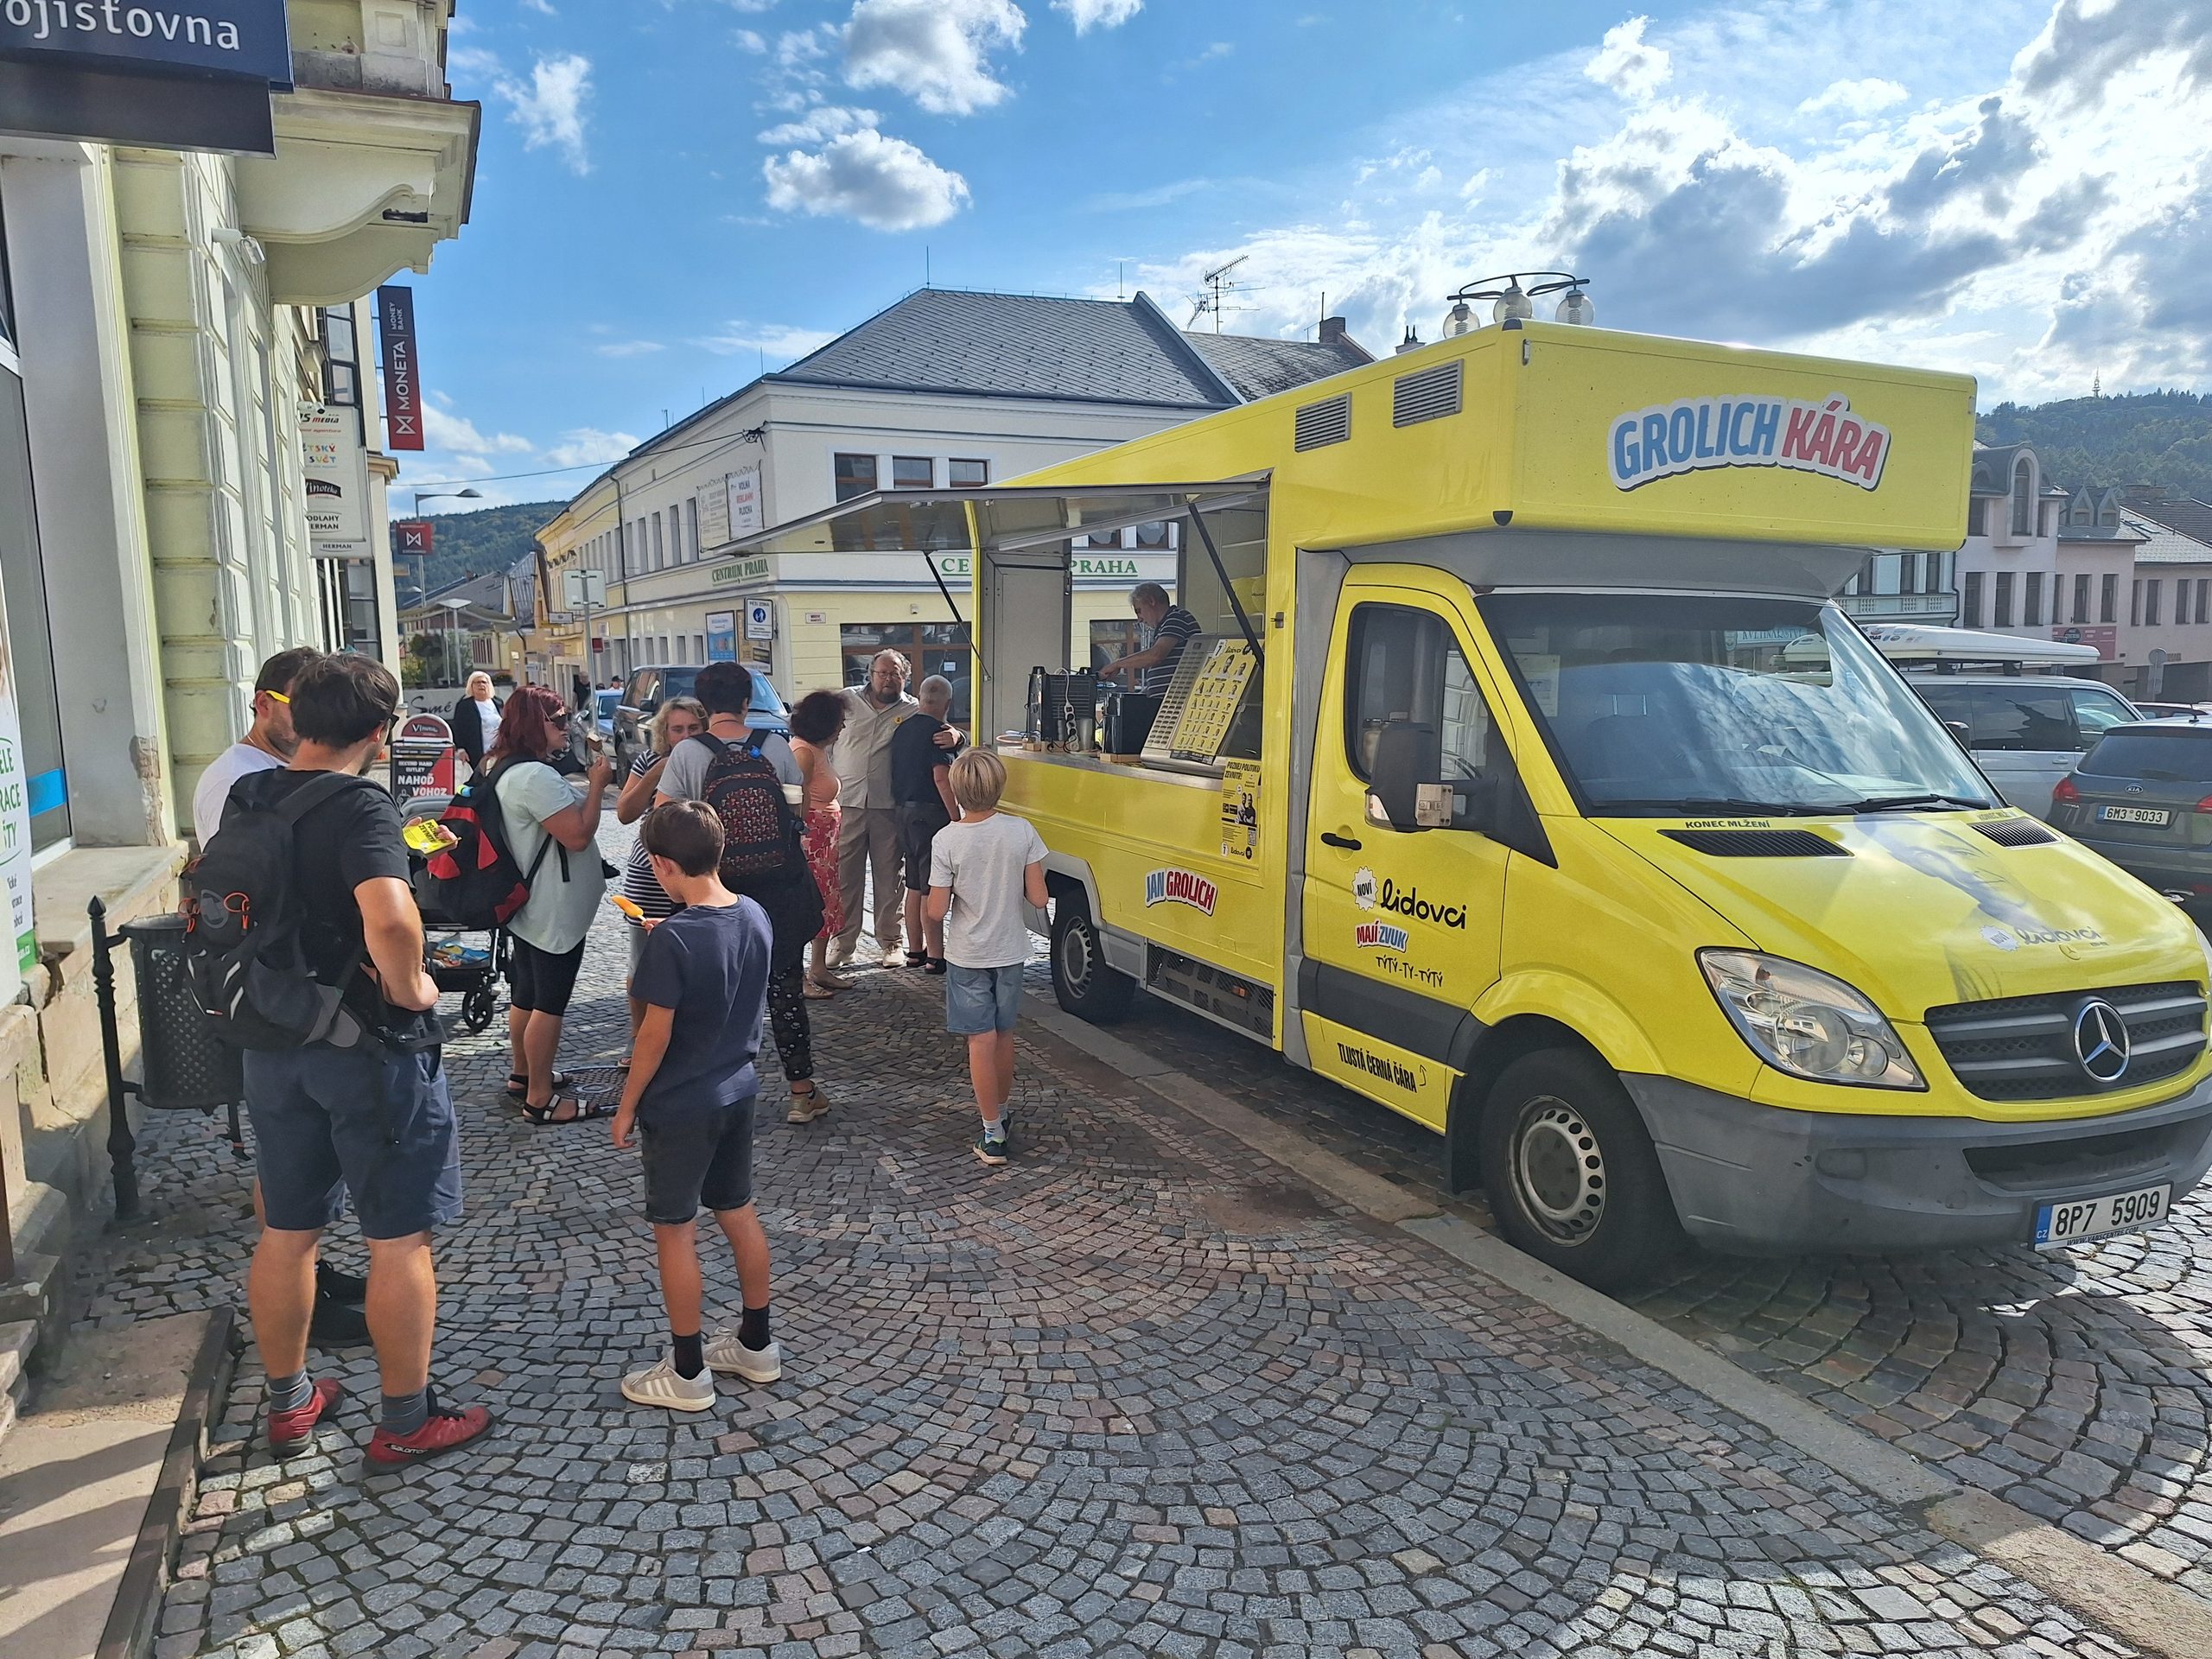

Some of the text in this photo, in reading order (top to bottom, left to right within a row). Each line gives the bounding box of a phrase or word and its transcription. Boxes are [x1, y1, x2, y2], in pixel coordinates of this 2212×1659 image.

[389, 302, 397, 330] MONEY
[392, 340, 410, 410] MONETA
[1614, 399, 1884, 480] GROLICH KÁRA
[712, 558, 769, 582] CENTRUM PRAHA
[1071, 559, 1138, 574] PRAHA
[397, 772, 435, 785] NAHOĎ
[412, 786, 448, 797] VOHOZ
[1685, 818, 1770, 829] KONEC MLŽENÍ
[2107, 808, 2163, 823] 6M3 9033
[1146, 870, 1216, 911] JAN GROLICH
[1357, 879, 1373, 897] NOVÍ
[1380, 878, 1467, 930] lidovci
[1356, 920, 1407, 950] MAJÍ ZVUK
[2013, 925, 2102, 945] lidovci
[1337, 1042, 1418, 1094] TLUSTÁ ČERNÁ ČÁRA
[2055, 1190, 2161, 1236] 8P7 5909
[2037, 1230, 2049, 1239] CZ
